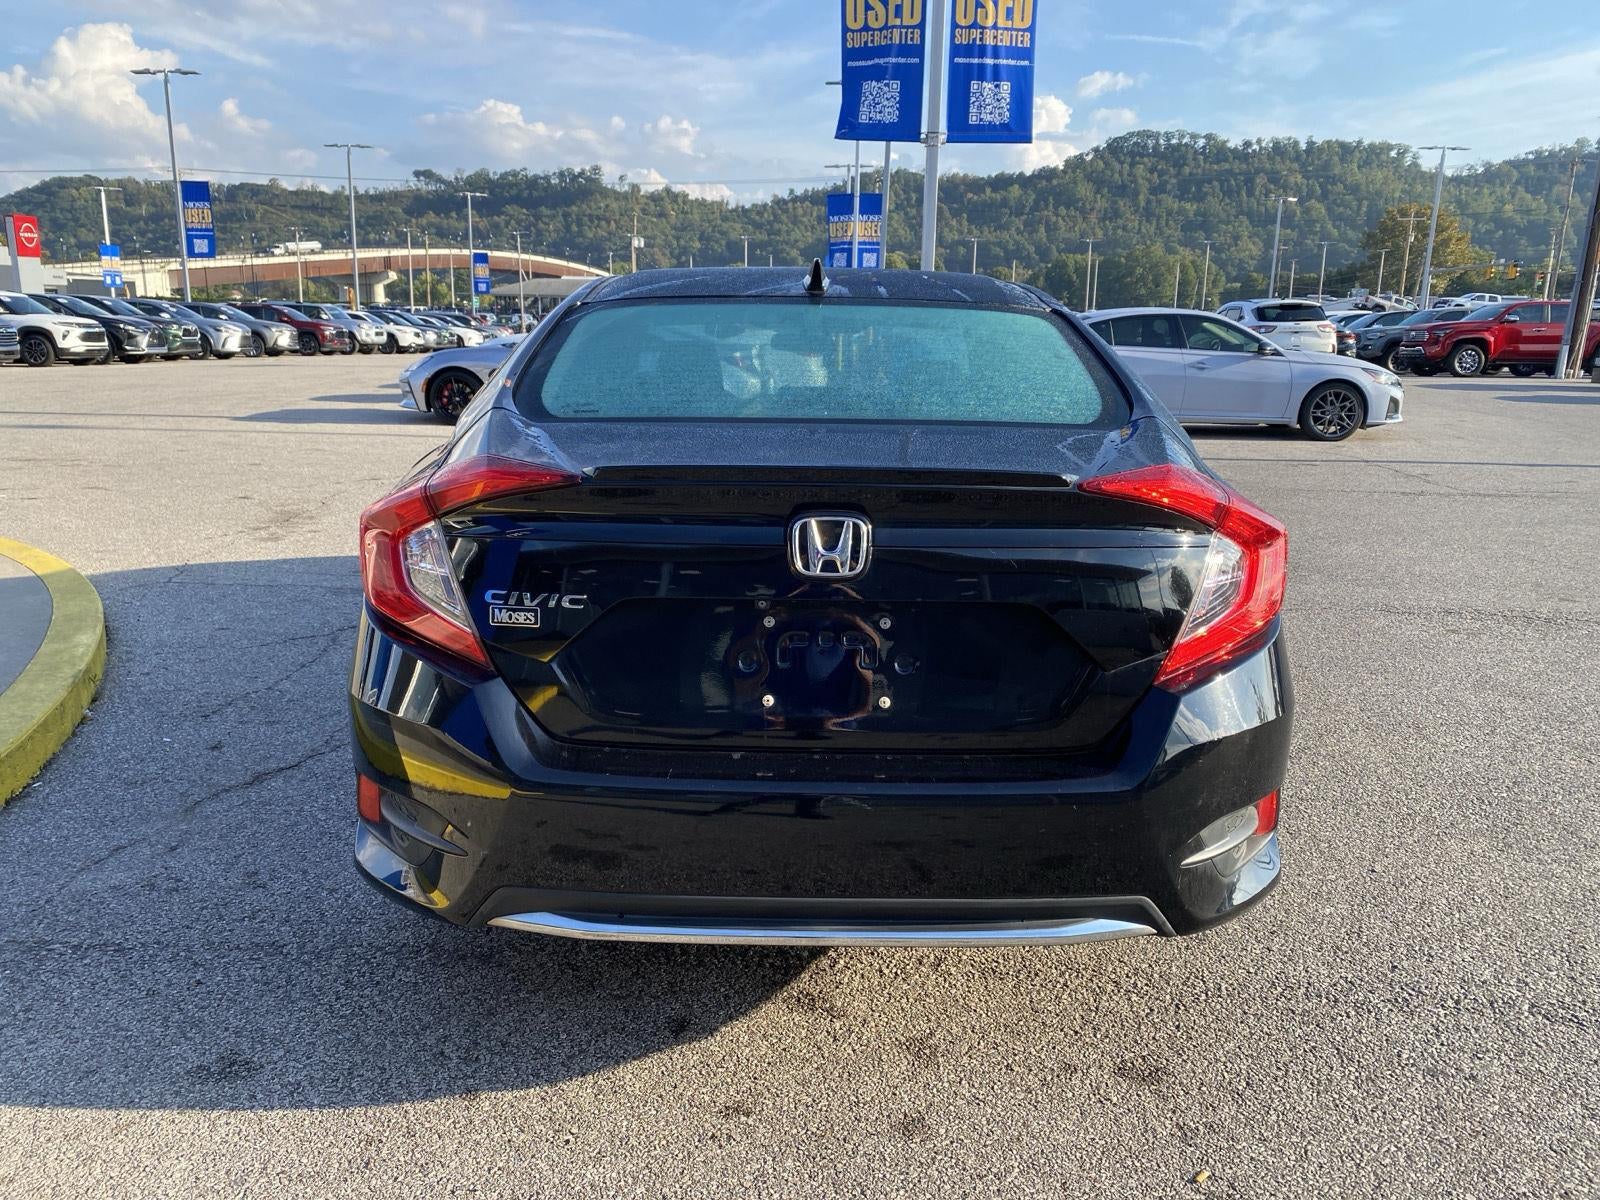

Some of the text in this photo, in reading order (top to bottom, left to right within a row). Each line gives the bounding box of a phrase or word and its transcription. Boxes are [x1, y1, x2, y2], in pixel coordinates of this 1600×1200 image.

[845, 0, 922, 30] USED
[955, 0, 1032, 29] USED
[846, 29, 921, 48] SUPERCENTER
[954, 28, 1031, 48] SUPERCENTER
[185, 208, 212, 223] USED
[829, 214, 855, 222] MOSES
[484, 589, 588, 609] CIVIC
